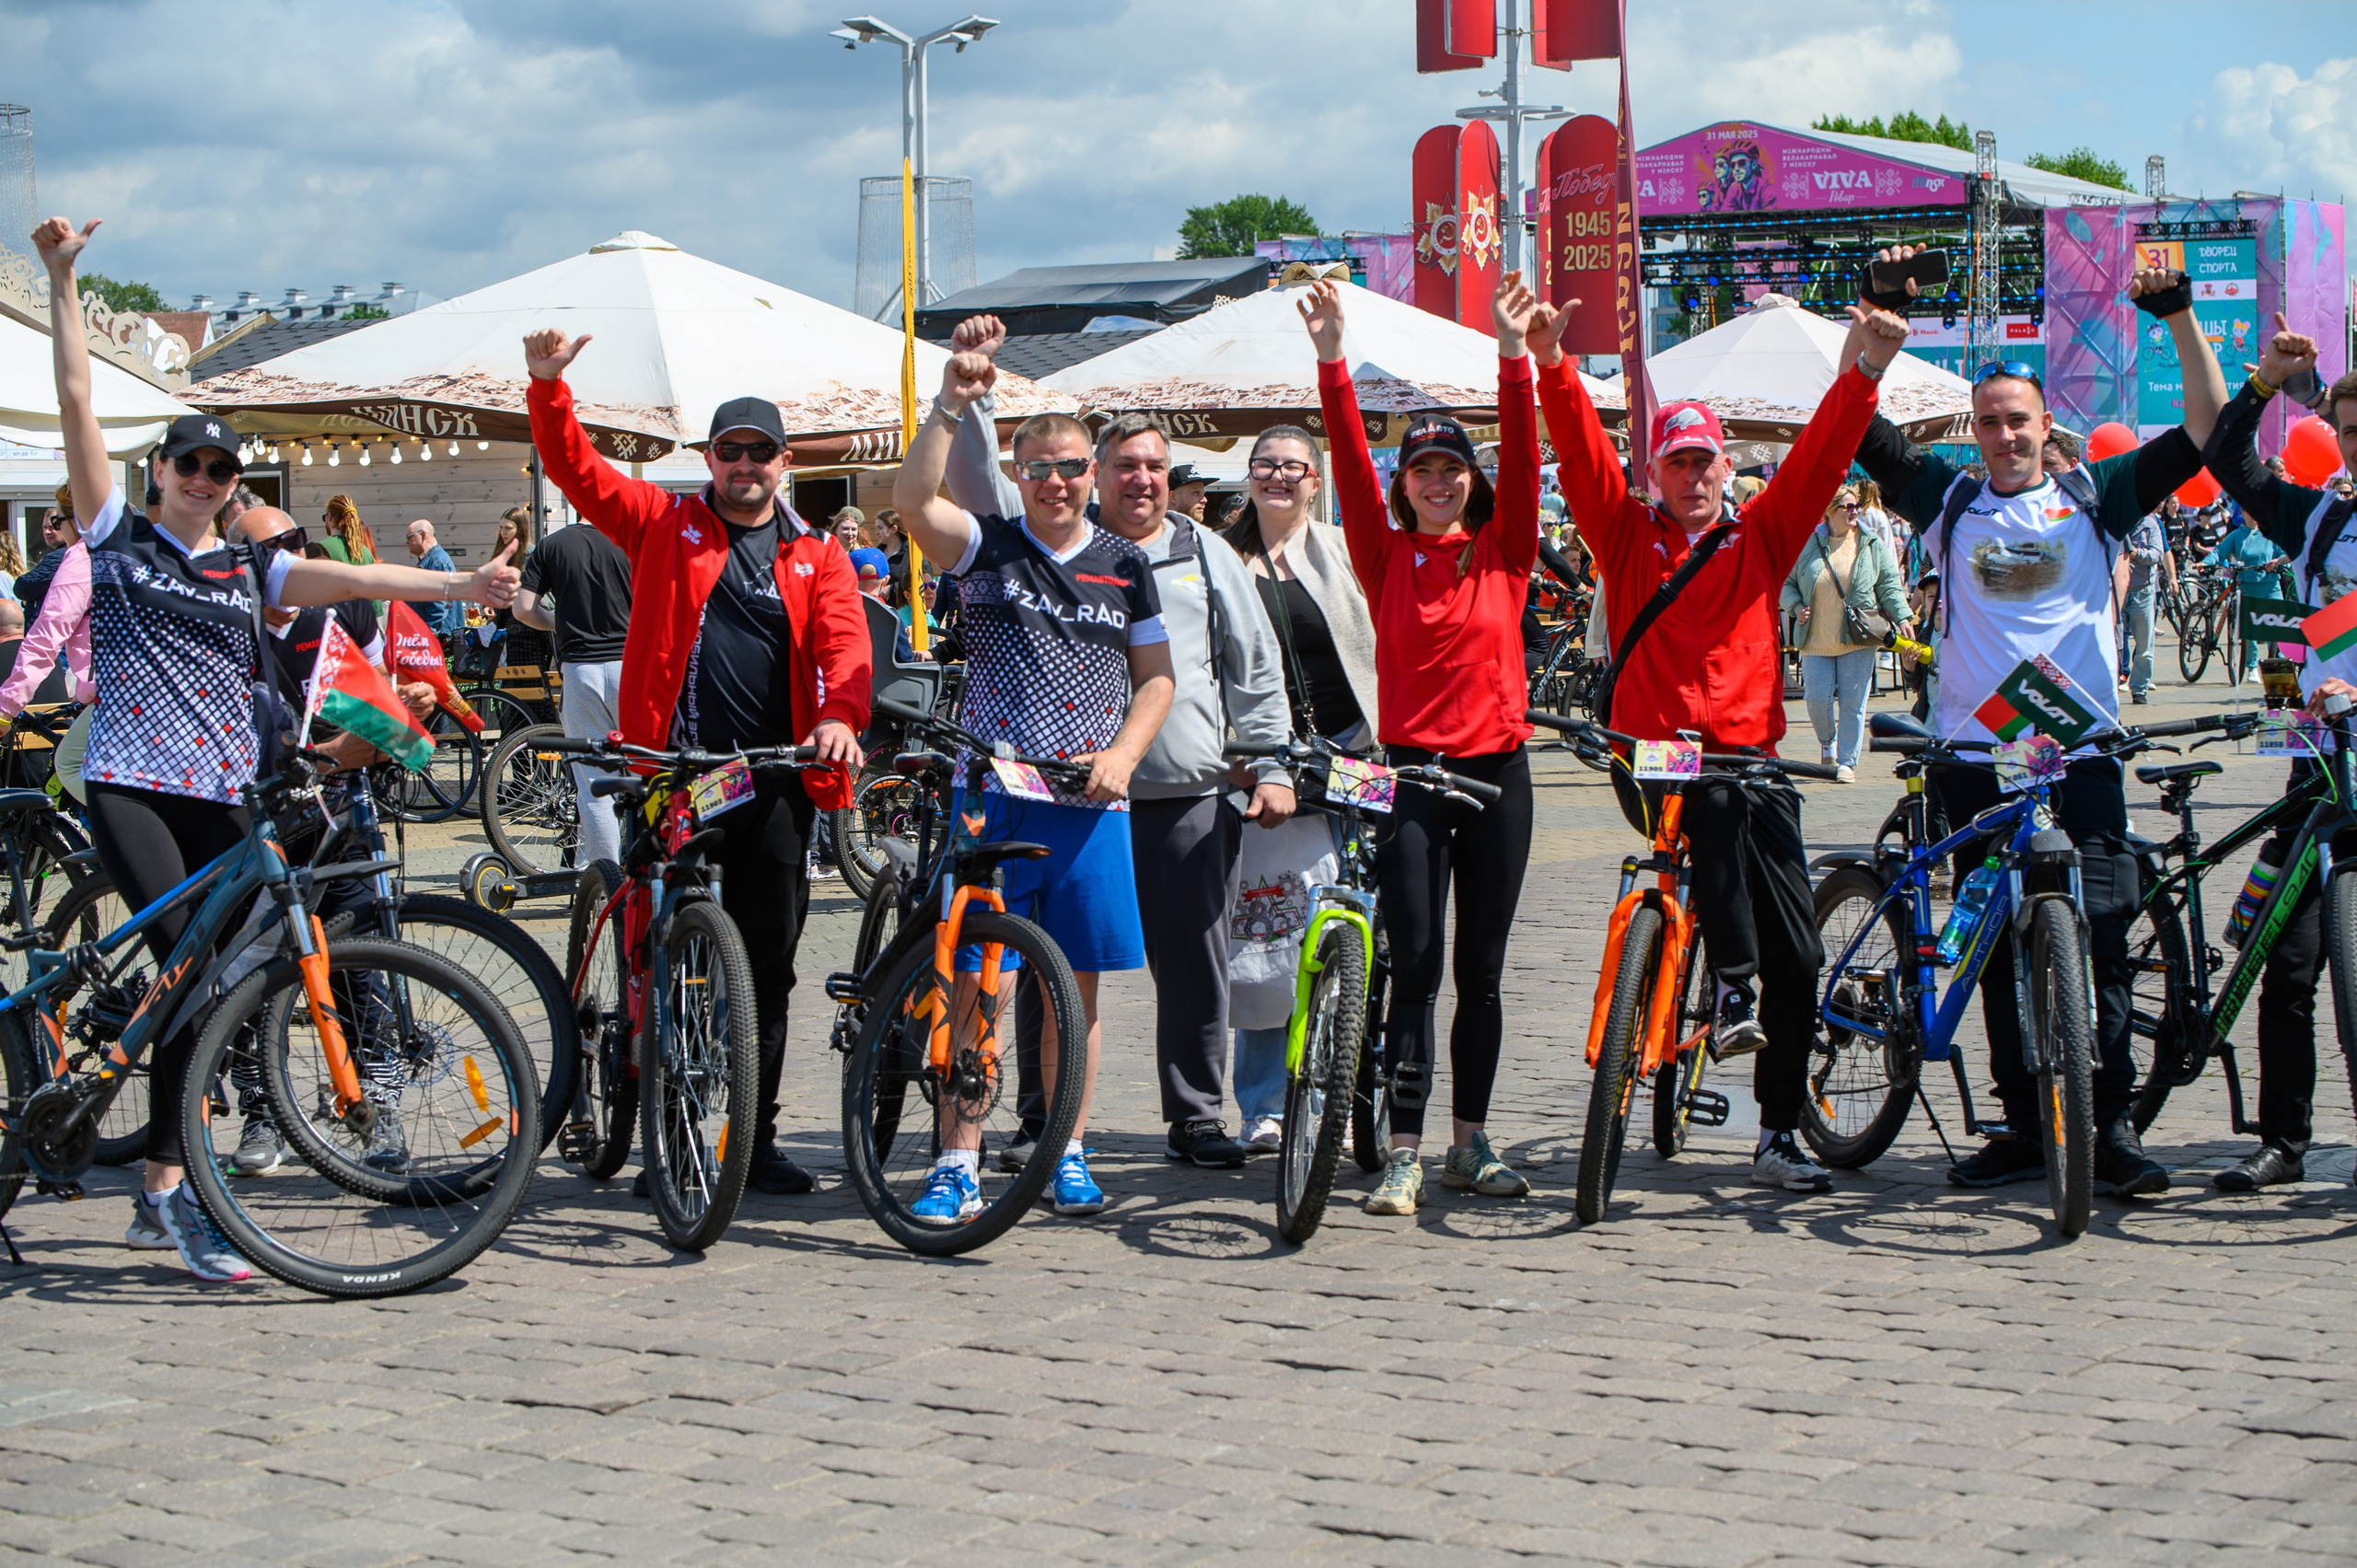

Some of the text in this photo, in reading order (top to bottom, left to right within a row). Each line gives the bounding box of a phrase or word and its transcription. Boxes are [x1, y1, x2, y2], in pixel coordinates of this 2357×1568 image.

[1706, 129, 1759, 141] 31 МАЯ 2025
[1812, 169, 1873, 190] VIVA
[1565, 211, 1611, 238] 1945
[1563, 244, 1611, 271] 2025
[2148, 248, 2169, 268] 31
[2199, 246, 2237, 257] ДВОРЕЦ
[2199, 262, 2237, 273] СПОРТА
[2148, 381, 2173, 391] Тема
[205, 422, 221, 438] NY
[1965, 506, 2002, 517] OLAT
[2249, 611, 2305, 630] VOLA
[2018, 679, 2078, 726] VOLAT
[701, 798, 723, 813] 11903
[1962, 894, 2009, 992] AUTHOR
[342, 1271, 402, 1283] KENDA
